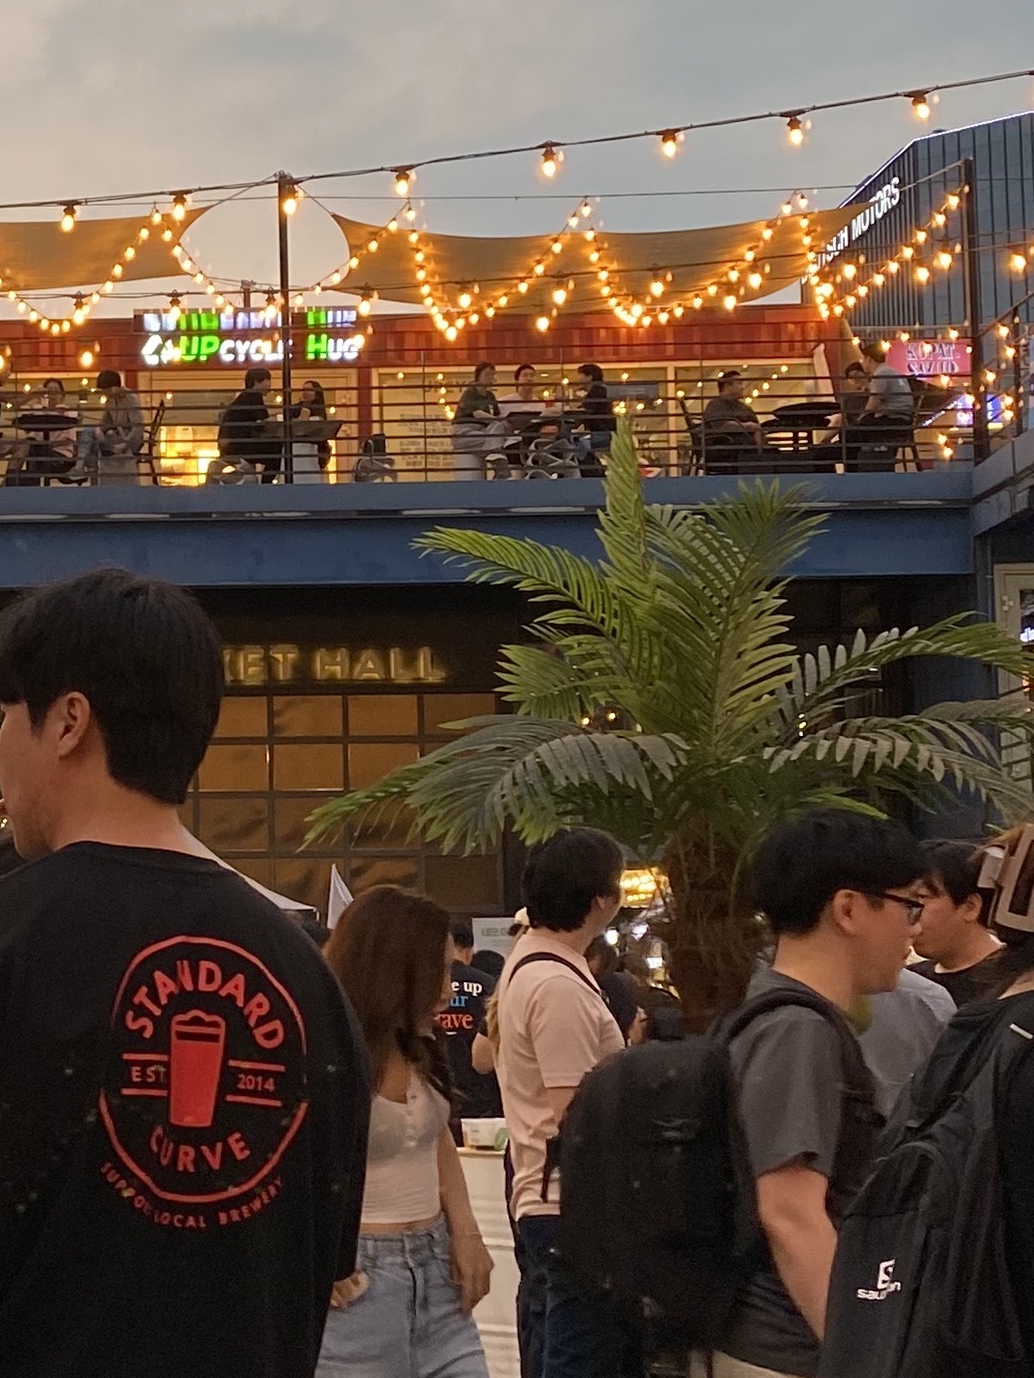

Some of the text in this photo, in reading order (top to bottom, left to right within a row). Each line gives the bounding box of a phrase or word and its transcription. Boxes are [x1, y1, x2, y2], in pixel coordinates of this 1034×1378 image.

[306, 333, 360, 362] HUG
[316, 646, 446, 683] HALL
[125, 959, 285, 1049] STANDARD
[463, 980, 482, 997] up
[237, 1073, 276, 1093] 2014
[149, 1125, 251, 1173] CURVE
